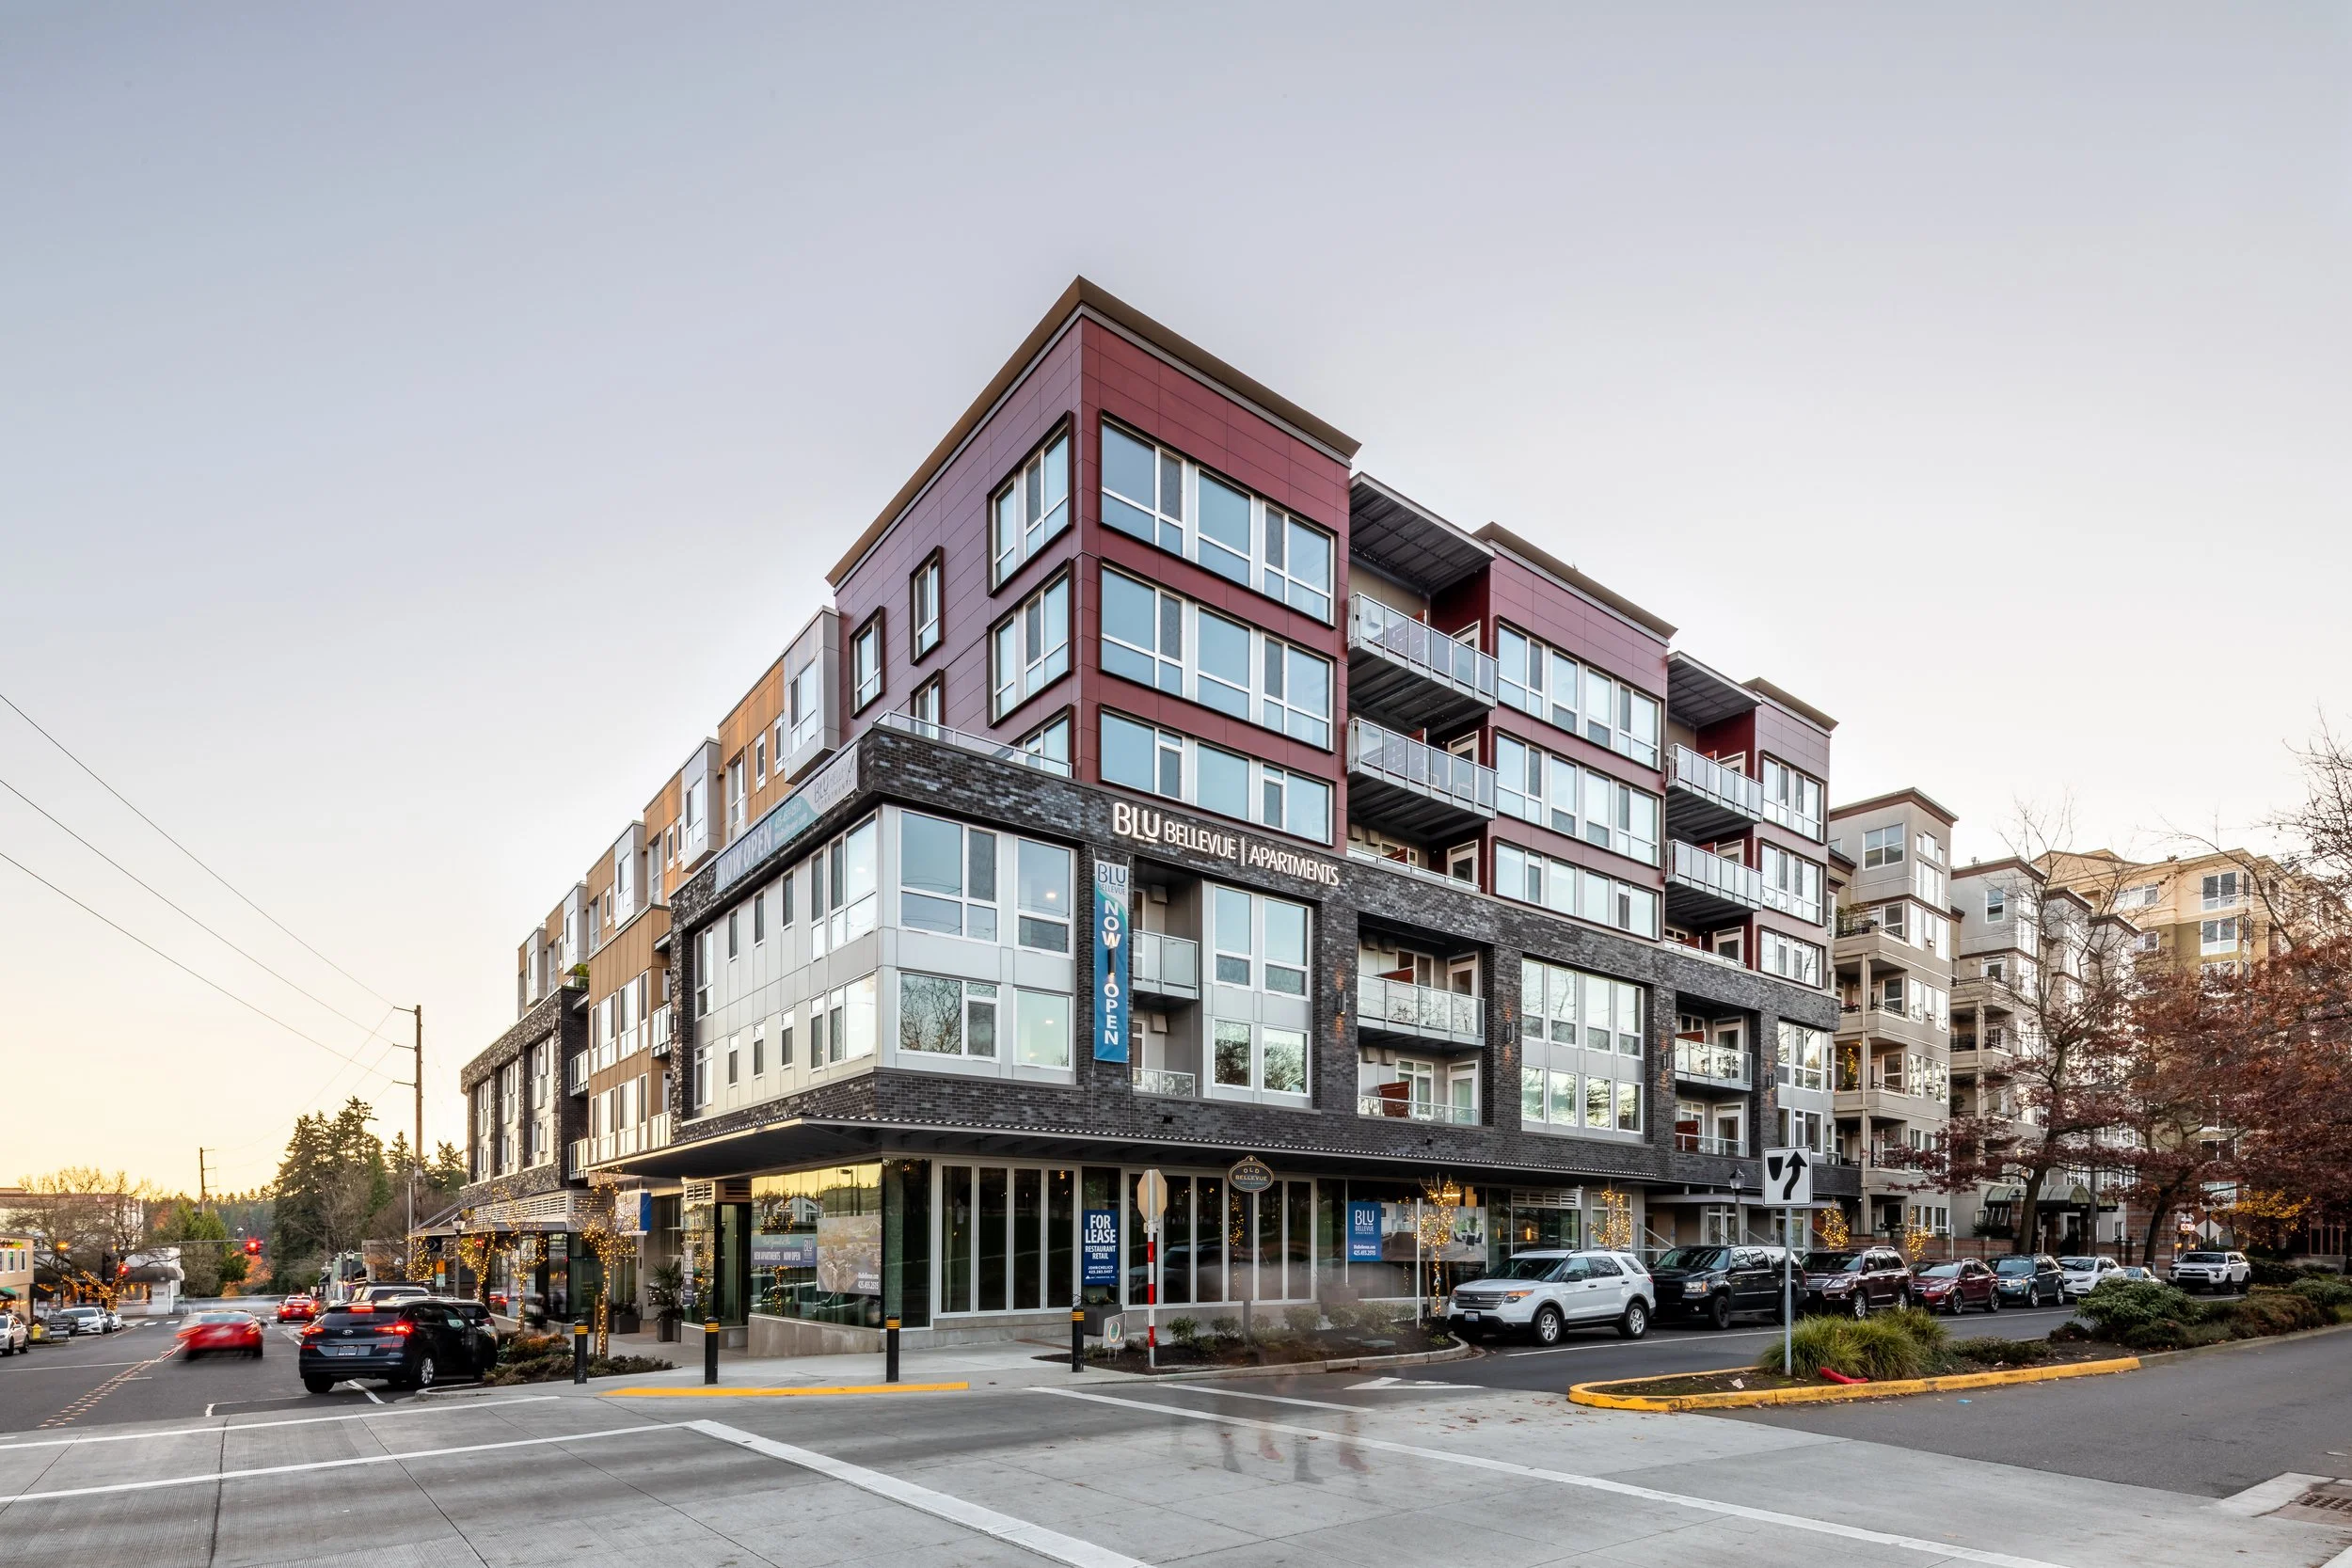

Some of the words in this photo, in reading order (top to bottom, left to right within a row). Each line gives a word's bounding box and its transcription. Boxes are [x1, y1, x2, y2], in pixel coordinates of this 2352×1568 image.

[815, 773, 829, 803] BLU
[1113, 801, 1160, 843] BLU
[1164, 820, 1237, 859] BELLEVUE
[1248, 845, 1340, 886] APARTMENTS
[719, 849, 742, 888] NOW
[743, 822, 771, 867] OPEN
[1097, 863, 1126, 888] BLU
[1097, 883, 1126, 895] BELLEVUE
[1102, 899, 1121, 948] NOW
[1104, 983, 1120, 1045] OPEN
[1089, 1214, 1111, 1229] FOR
[1355, 1210, 1375, 1226] BLU
[803, 1239, 813, 1252] BLU
[1085, 1228, 1117, 1243] LEASE
[783, 1251, 791, 1260] NOW
[791, 1251, 802, 1260] OPEN
